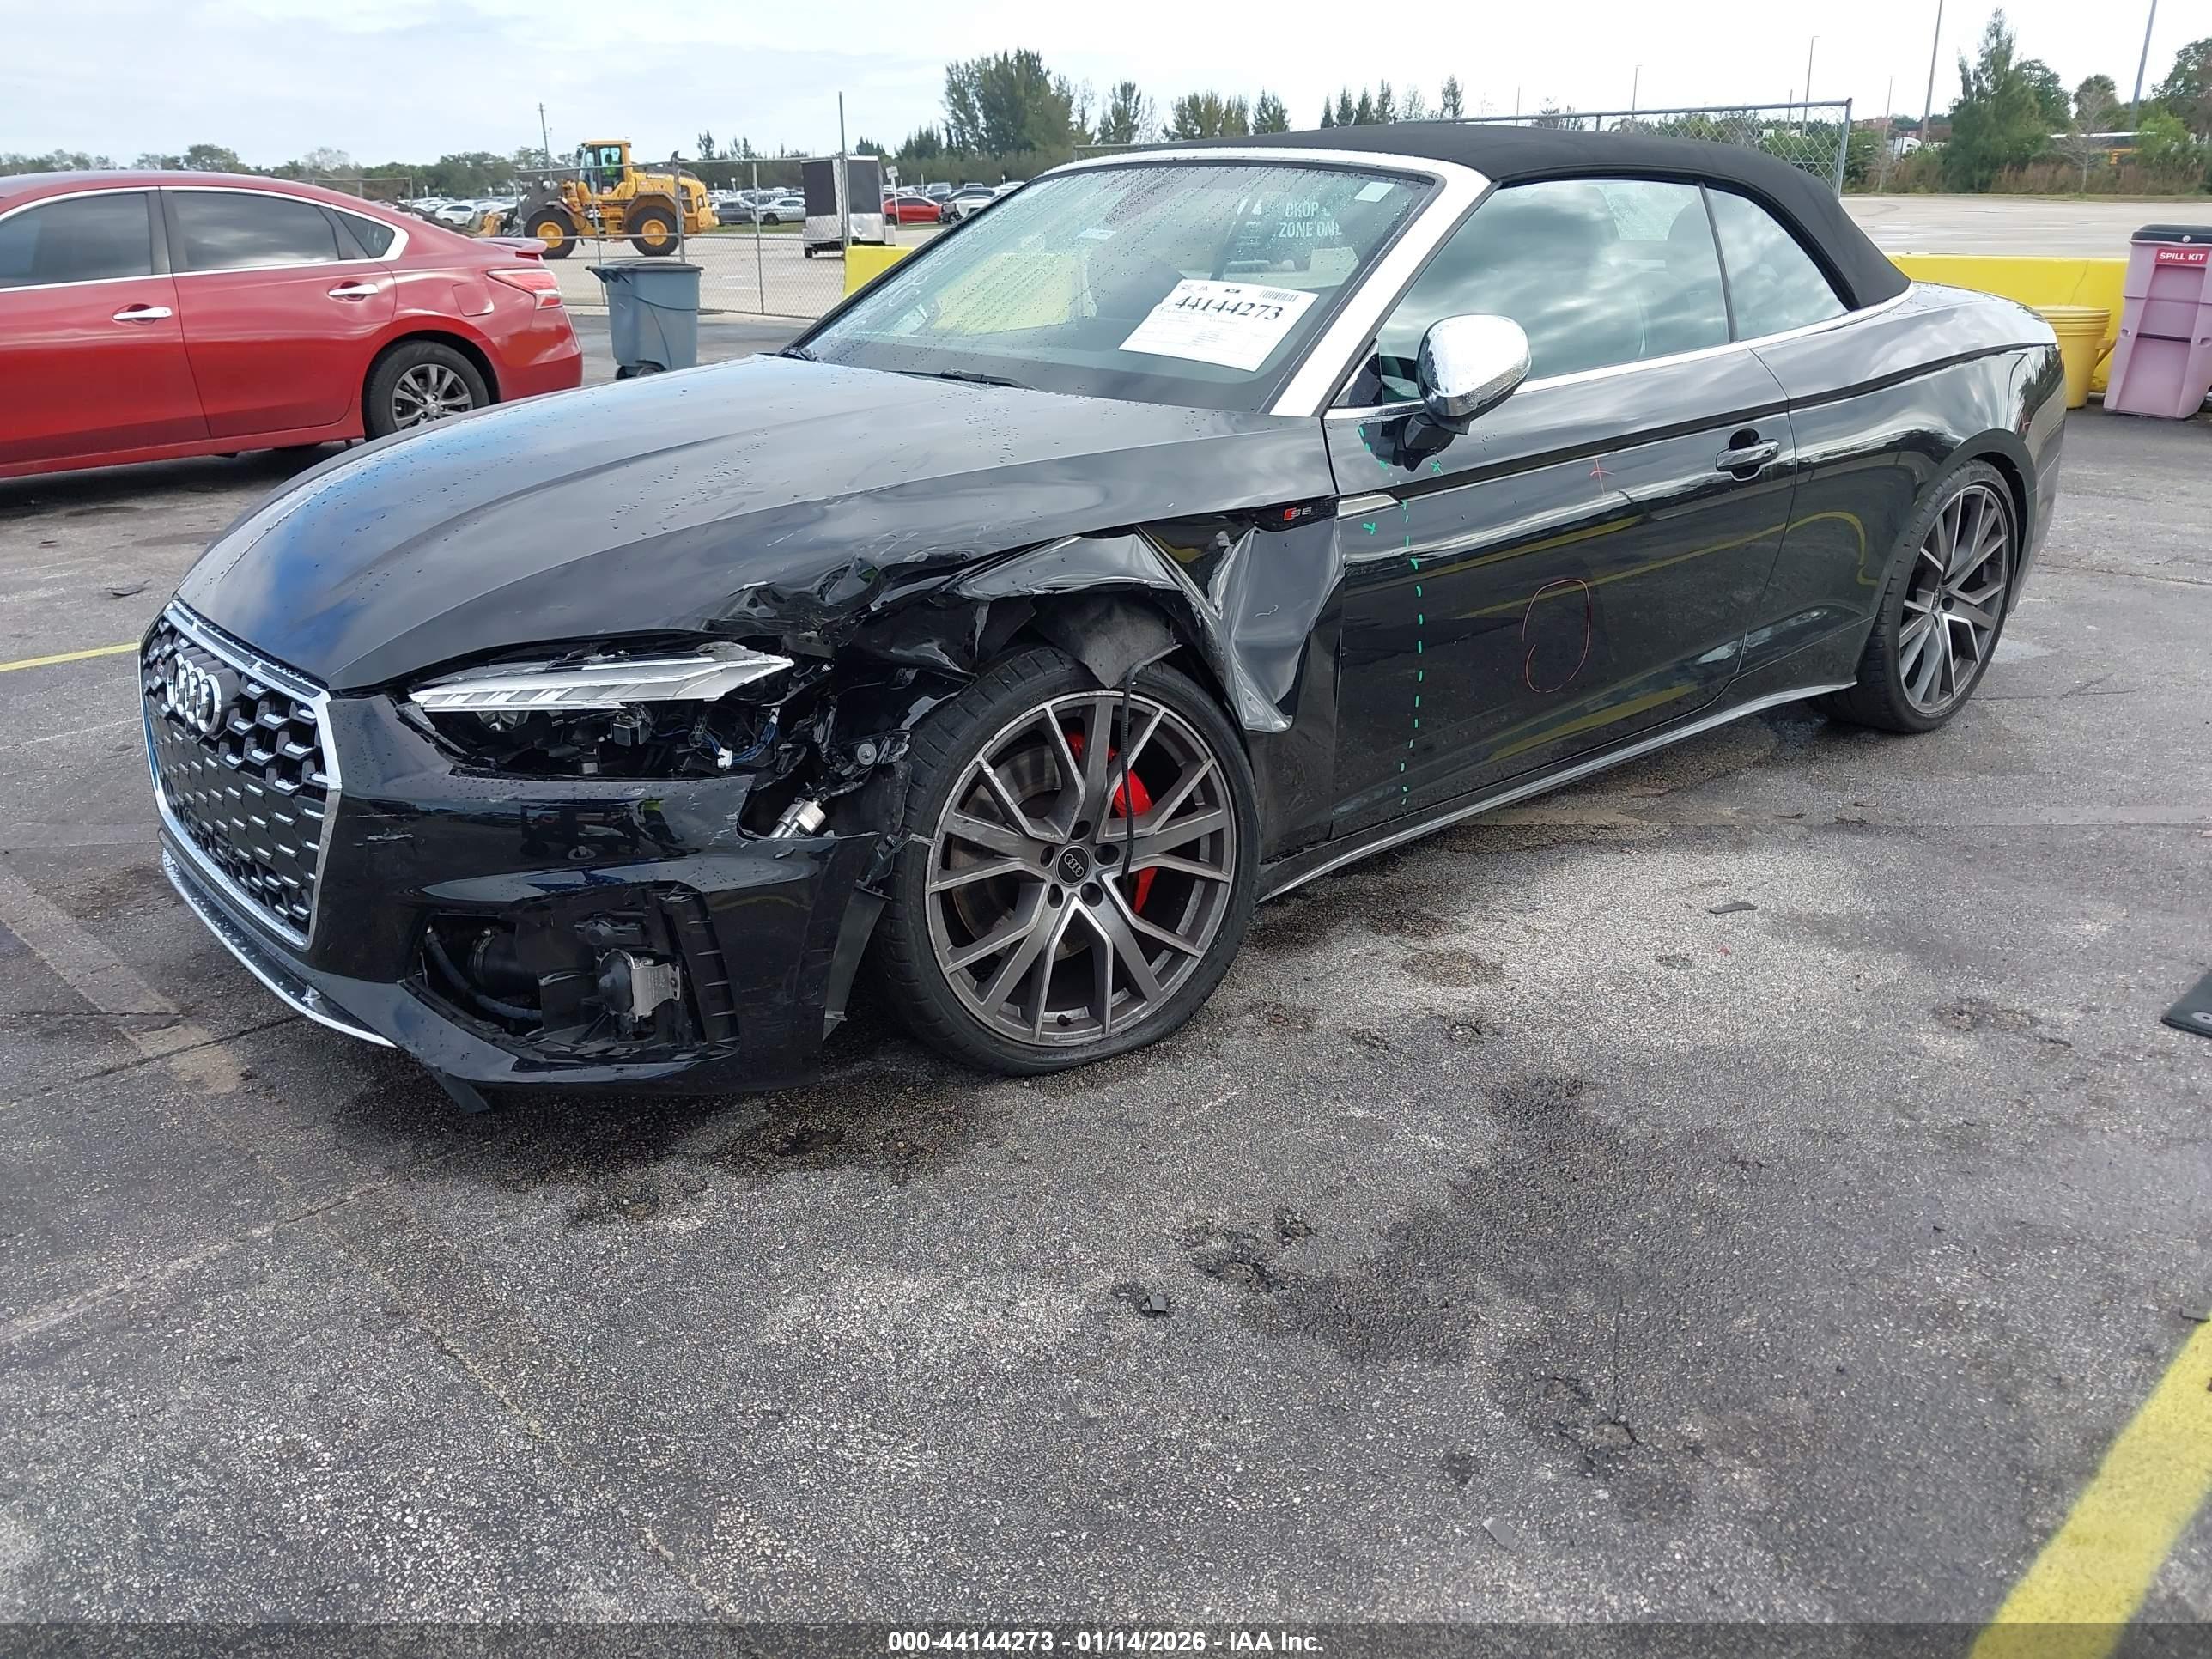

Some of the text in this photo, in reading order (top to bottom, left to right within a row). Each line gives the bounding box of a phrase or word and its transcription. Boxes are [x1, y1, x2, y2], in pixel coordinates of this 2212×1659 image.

[1279, 222, 1313, 237] ZONE
[2160, 252, 2185, 260] SPILL
[1175, 295, 1284, 320] 44144273
